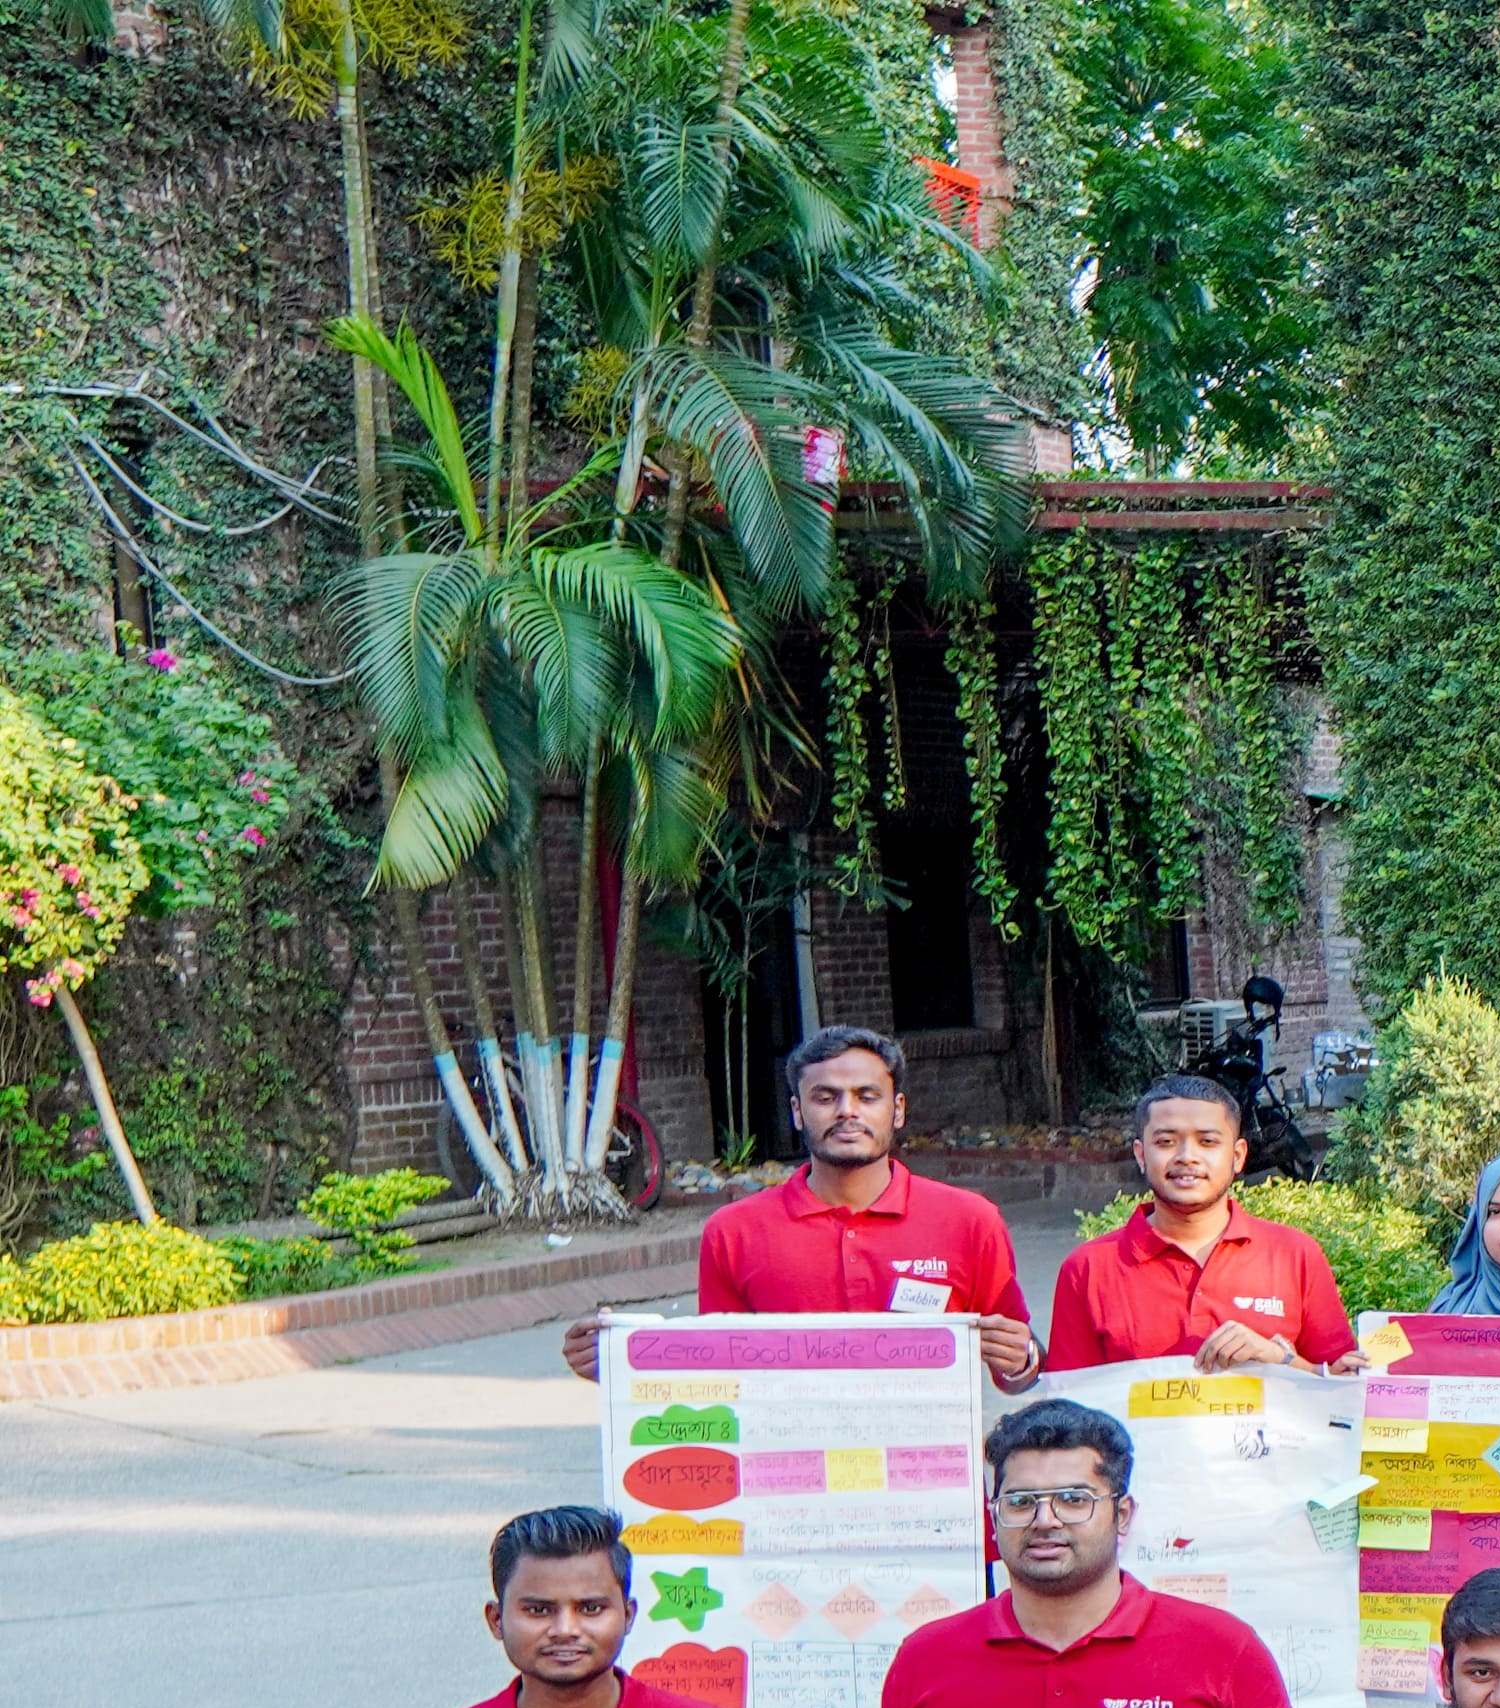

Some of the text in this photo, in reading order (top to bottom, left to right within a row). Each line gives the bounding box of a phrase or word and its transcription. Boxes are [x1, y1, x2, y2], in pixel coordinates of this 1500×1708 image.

[913, 1257, 948, 1275] gain
[1254, 1296, 1284, 1313] gain
[728, 1333, 952, 1364] Food Waste Campus
